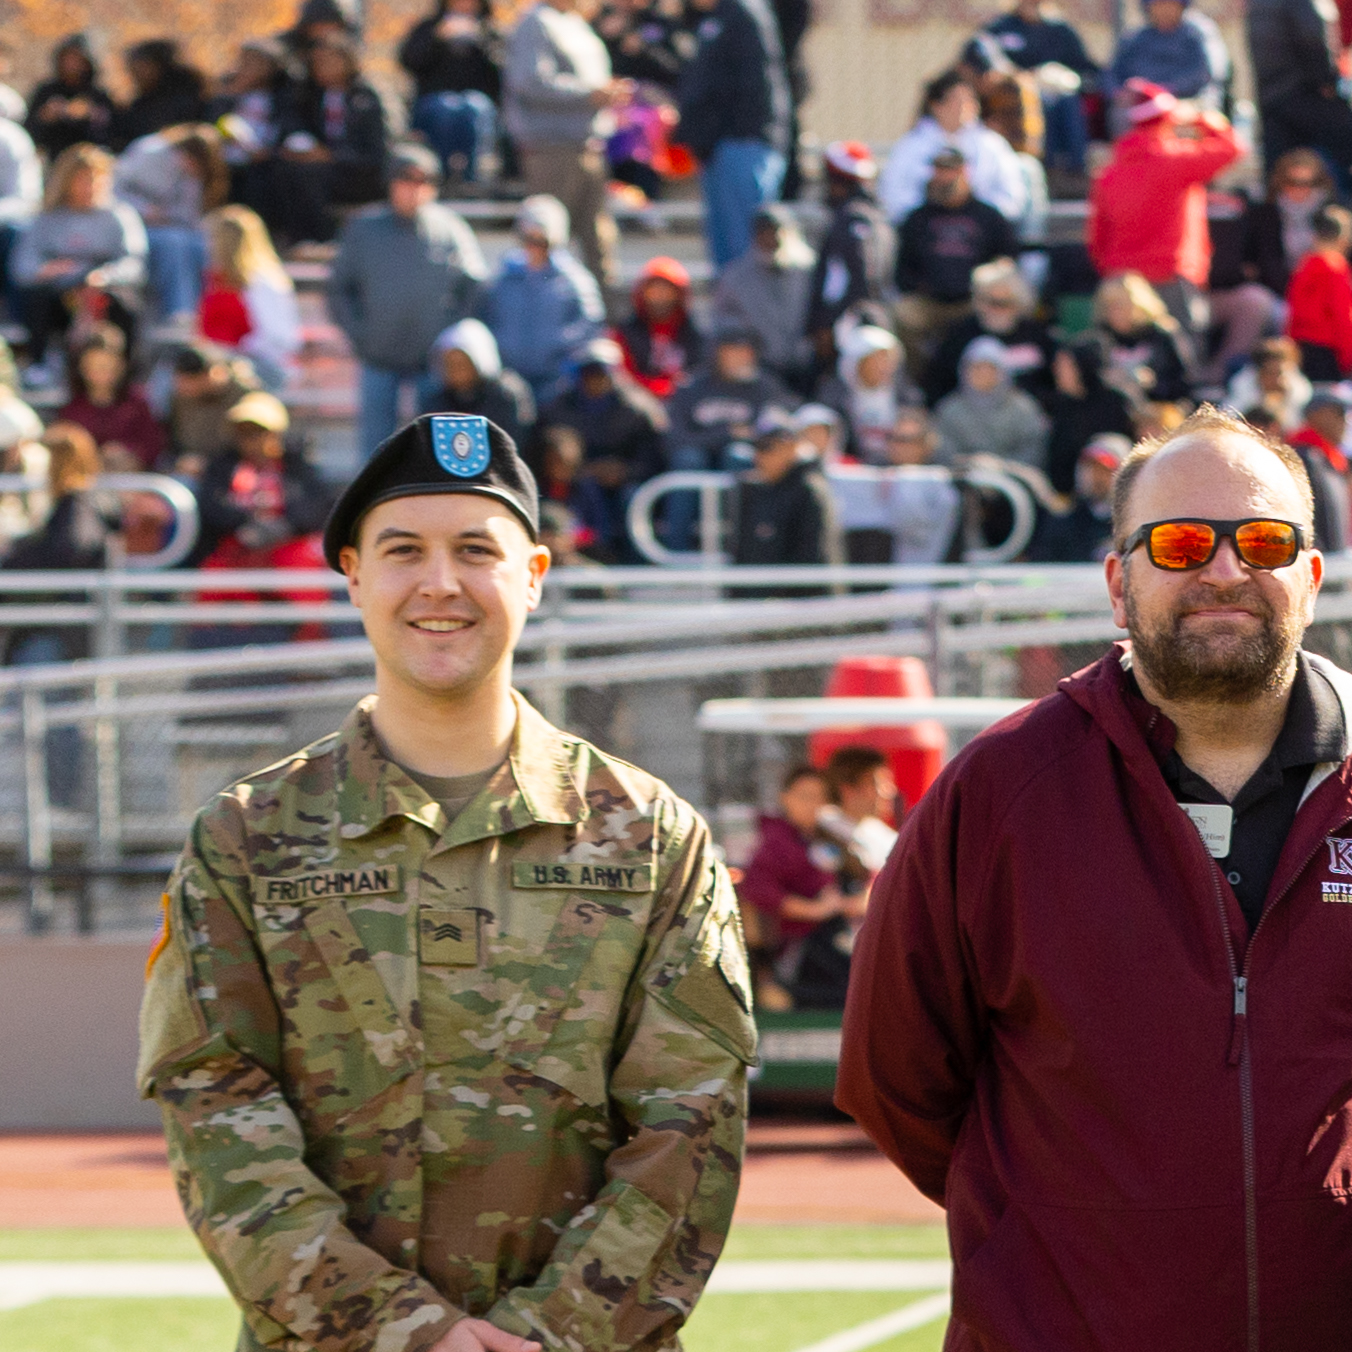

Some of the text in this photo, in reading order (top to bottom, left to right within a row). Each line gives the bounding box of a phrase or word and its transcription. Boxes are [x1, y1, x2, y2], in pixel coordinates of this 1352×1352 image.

[267, 868, 389, 900] FRITCHMAN
[535, 865, 638, 888] U.S. ARMY
